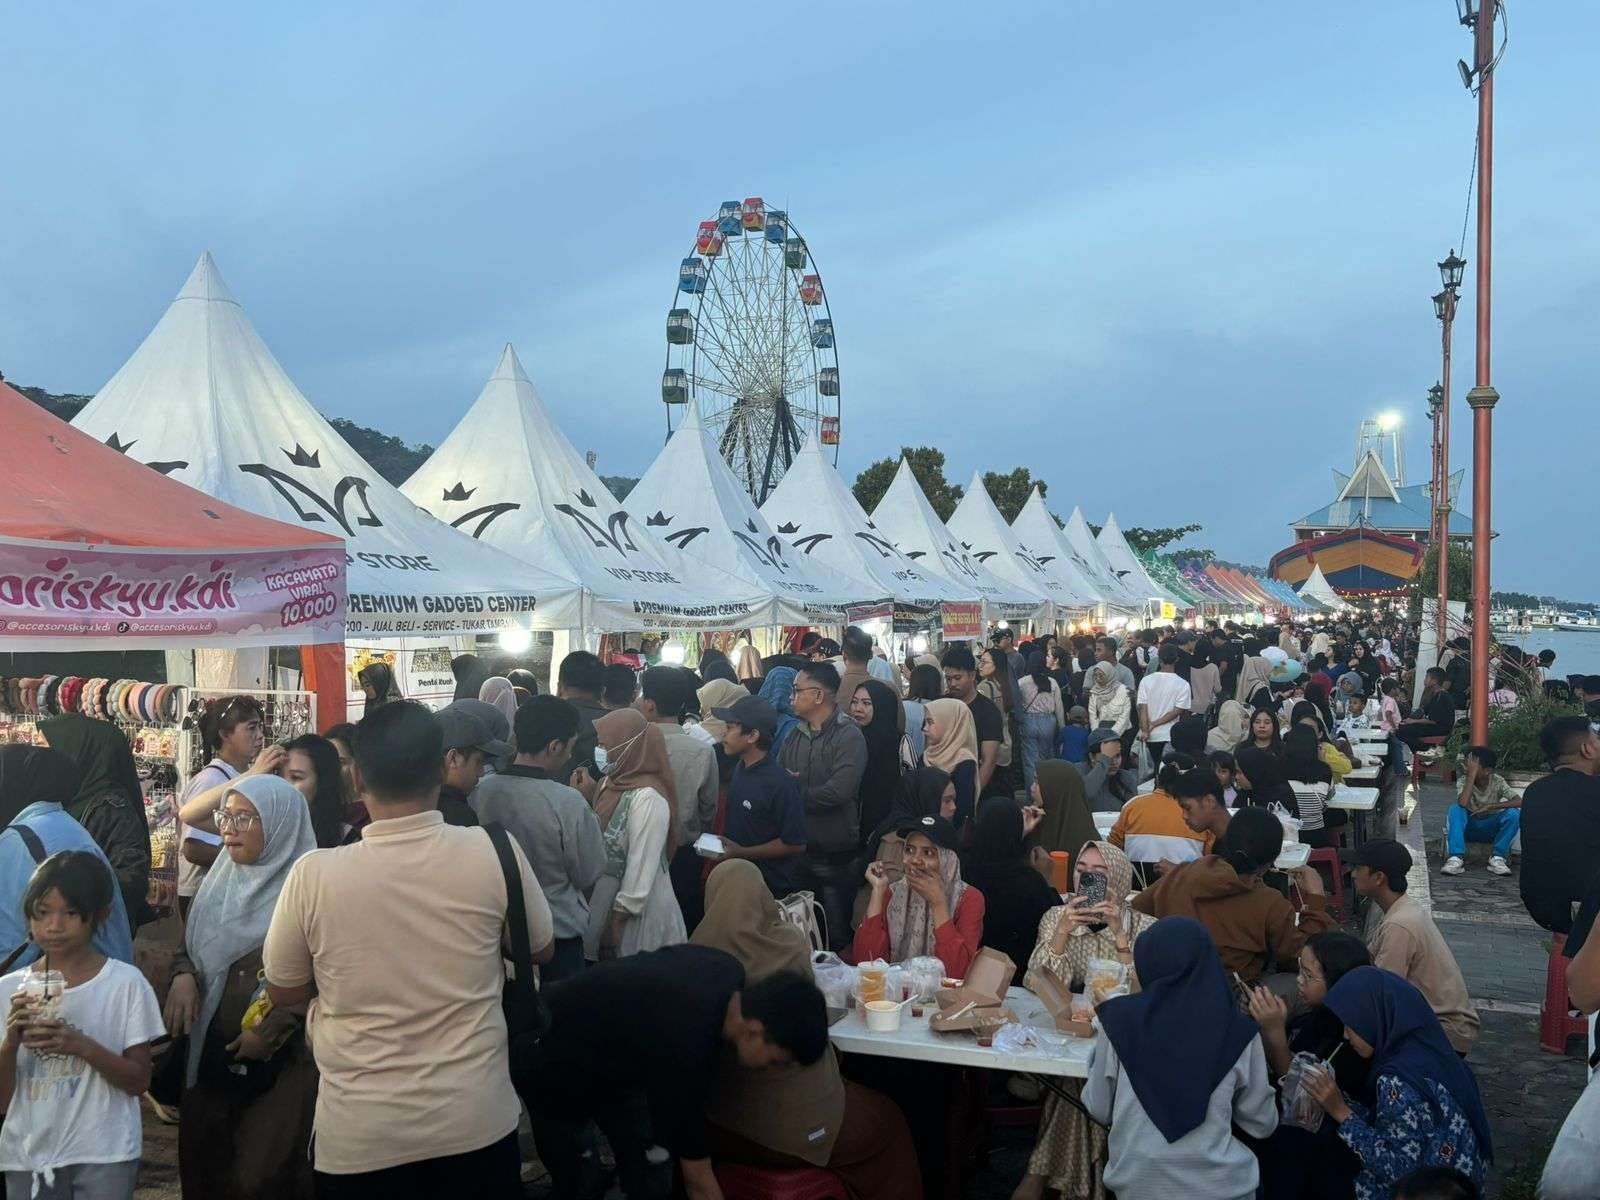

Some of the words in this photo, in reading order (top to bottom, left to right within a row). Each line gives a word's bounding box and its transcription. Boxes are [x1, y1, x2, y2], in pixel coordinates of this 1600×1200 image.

[357, 551, 440, 571] STORE
[267, 564, 337, 590] KACAMATA
[631, 569, 681, 584] STORE
[290, 582, 325, 600] VIRAL
[282, 595, 334, 624] 10.000
[423, 596, 484, 613] GADGED
[487, 595, 536, 612] CENTER
[372, 620, 393, 632] JUAL
[396, 620, 416, 632] BELI
[422, 620, 455, 632] SERVICE
[462, 619, 485, 630] TUKAR
